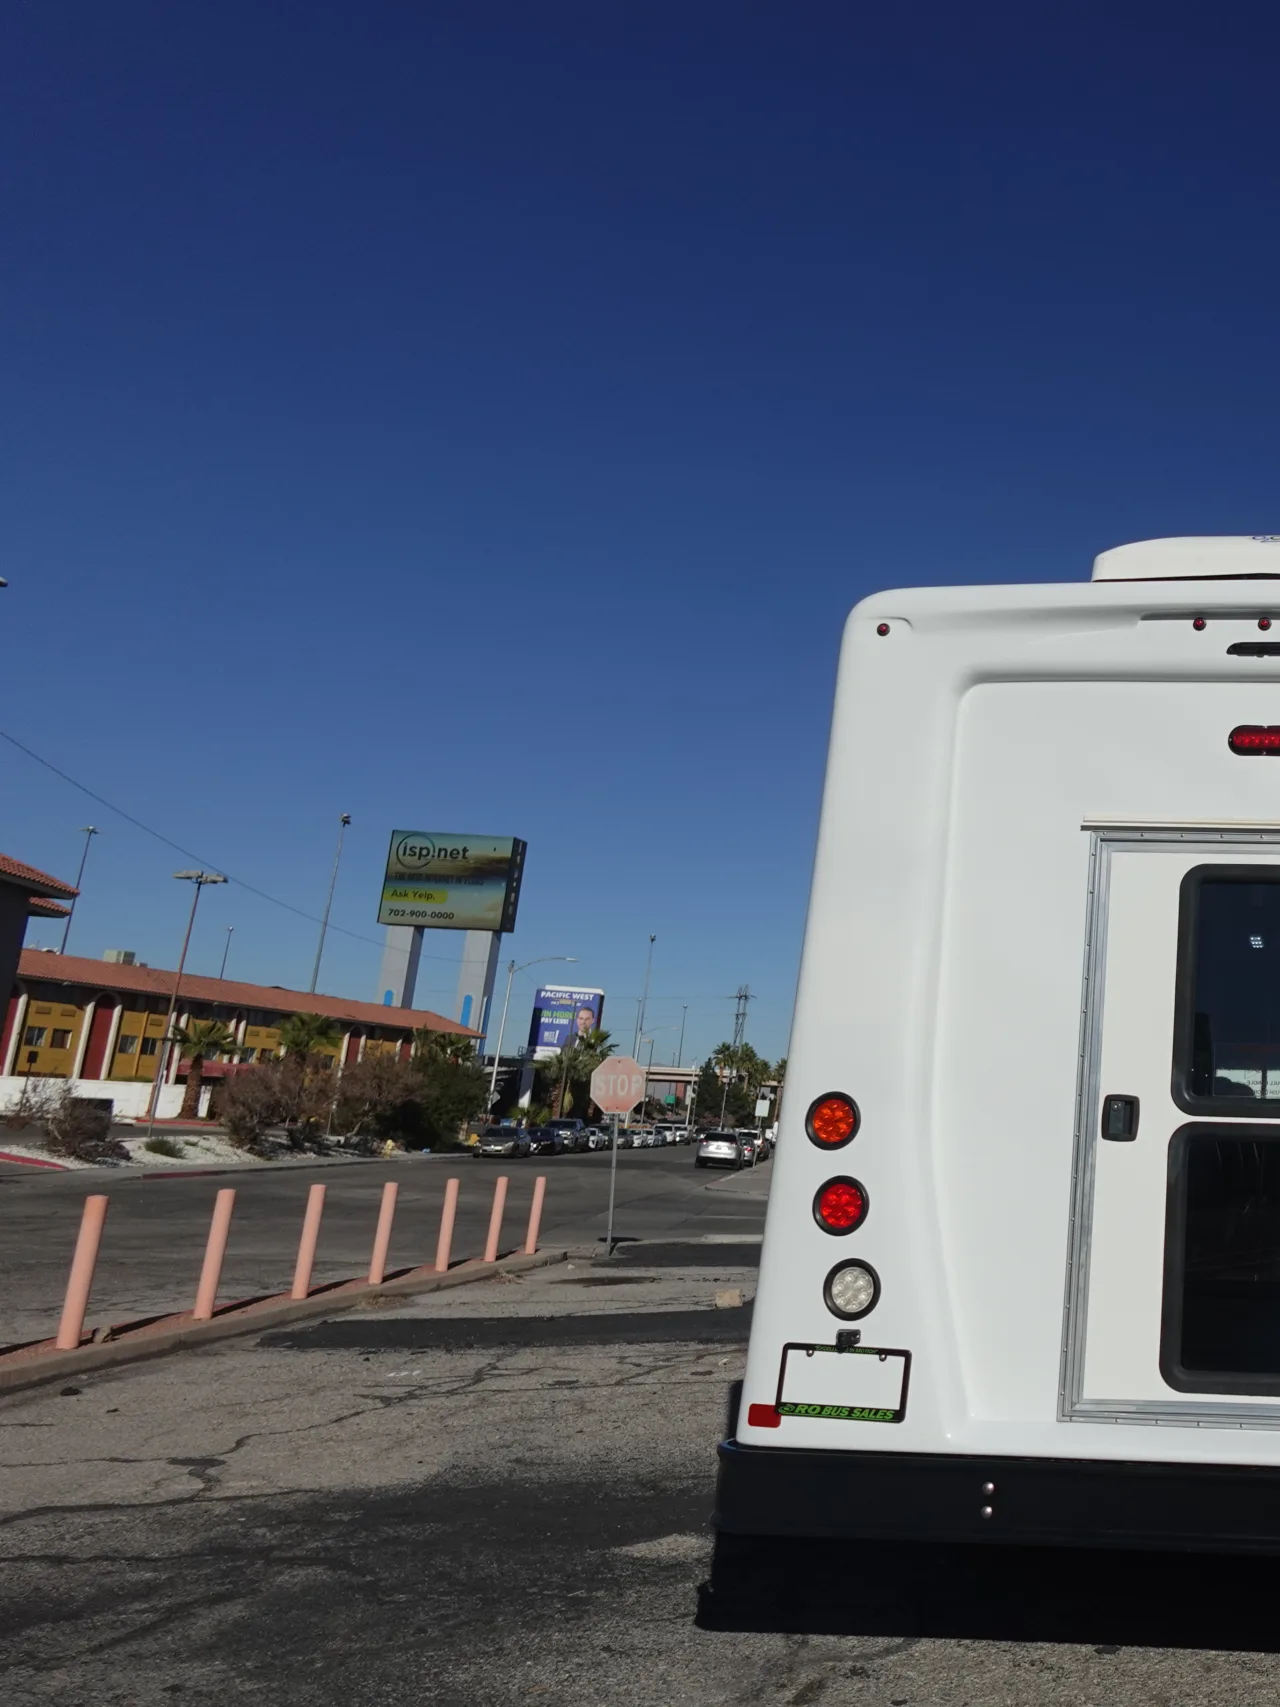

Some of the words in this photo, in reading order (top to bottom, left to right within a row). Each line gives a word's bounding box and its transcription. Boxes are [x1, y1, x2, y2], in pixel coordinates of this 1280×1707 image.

[402, 842, 469, 860] isp.net
[391, 889, 409, 899] Ask
[388, 909, 455, 920] 702-900-0000
[541, 991, 571, 999] PACIFIC
[572, 993, 594, 1001] WEST
[596, 1074, 642, 1096] STOP
[821, 1406, 851, 1417] BUS
[851, 1409, 895, 1420] SALES
